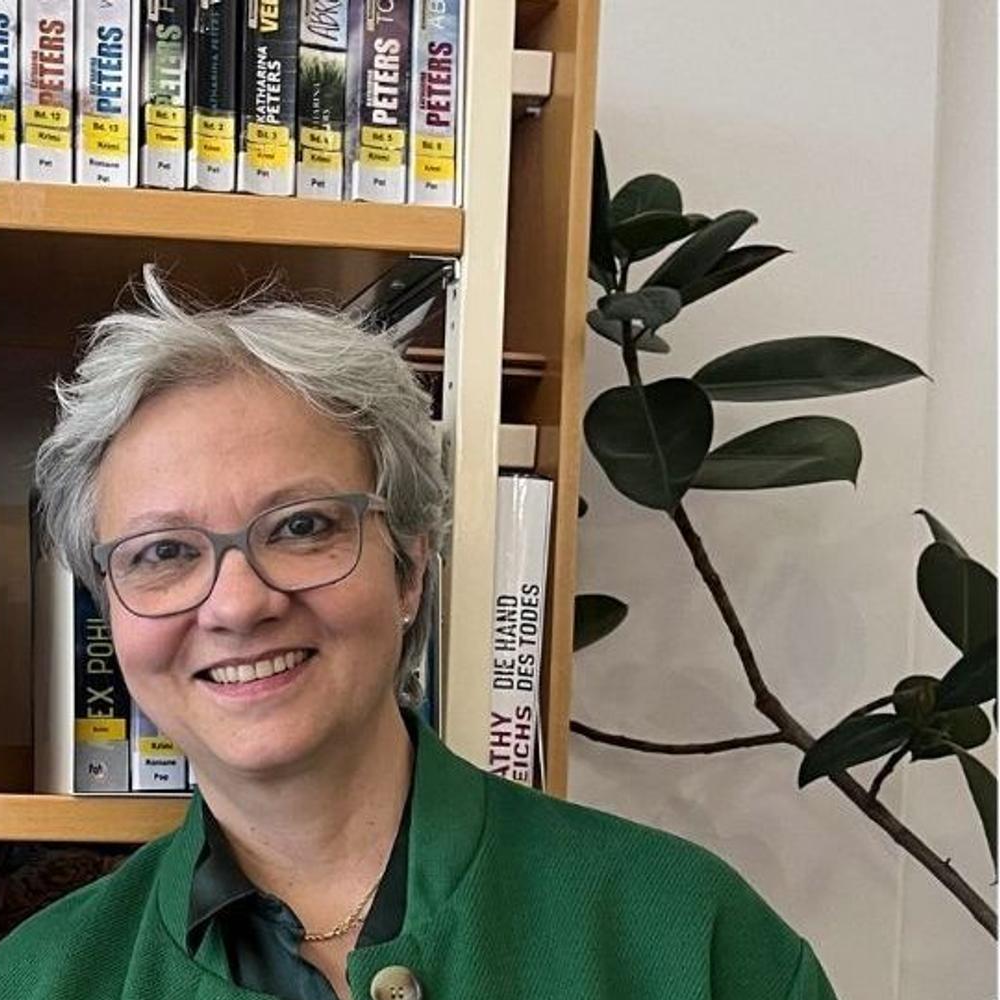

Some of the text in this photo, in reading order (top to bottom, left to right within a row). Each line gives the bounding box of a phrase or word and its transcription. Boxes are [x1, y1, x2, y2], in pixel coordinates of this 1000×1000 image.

[39, 18, 65, 105] PETERS
[97, 25, 124, 114] PETERS
[255, 46, 268, 124] KATHARINA
[266, 60, 281, 124] PETERS
[372, 38, 400, 124] PETERS
[426, 41, 453, 127] PETERS
[86, 687, 114, 718] EX
[490, 594, 518, 777] ATHY DIE HAND
[513, 584, 540, 783] EICHS DES TODES
